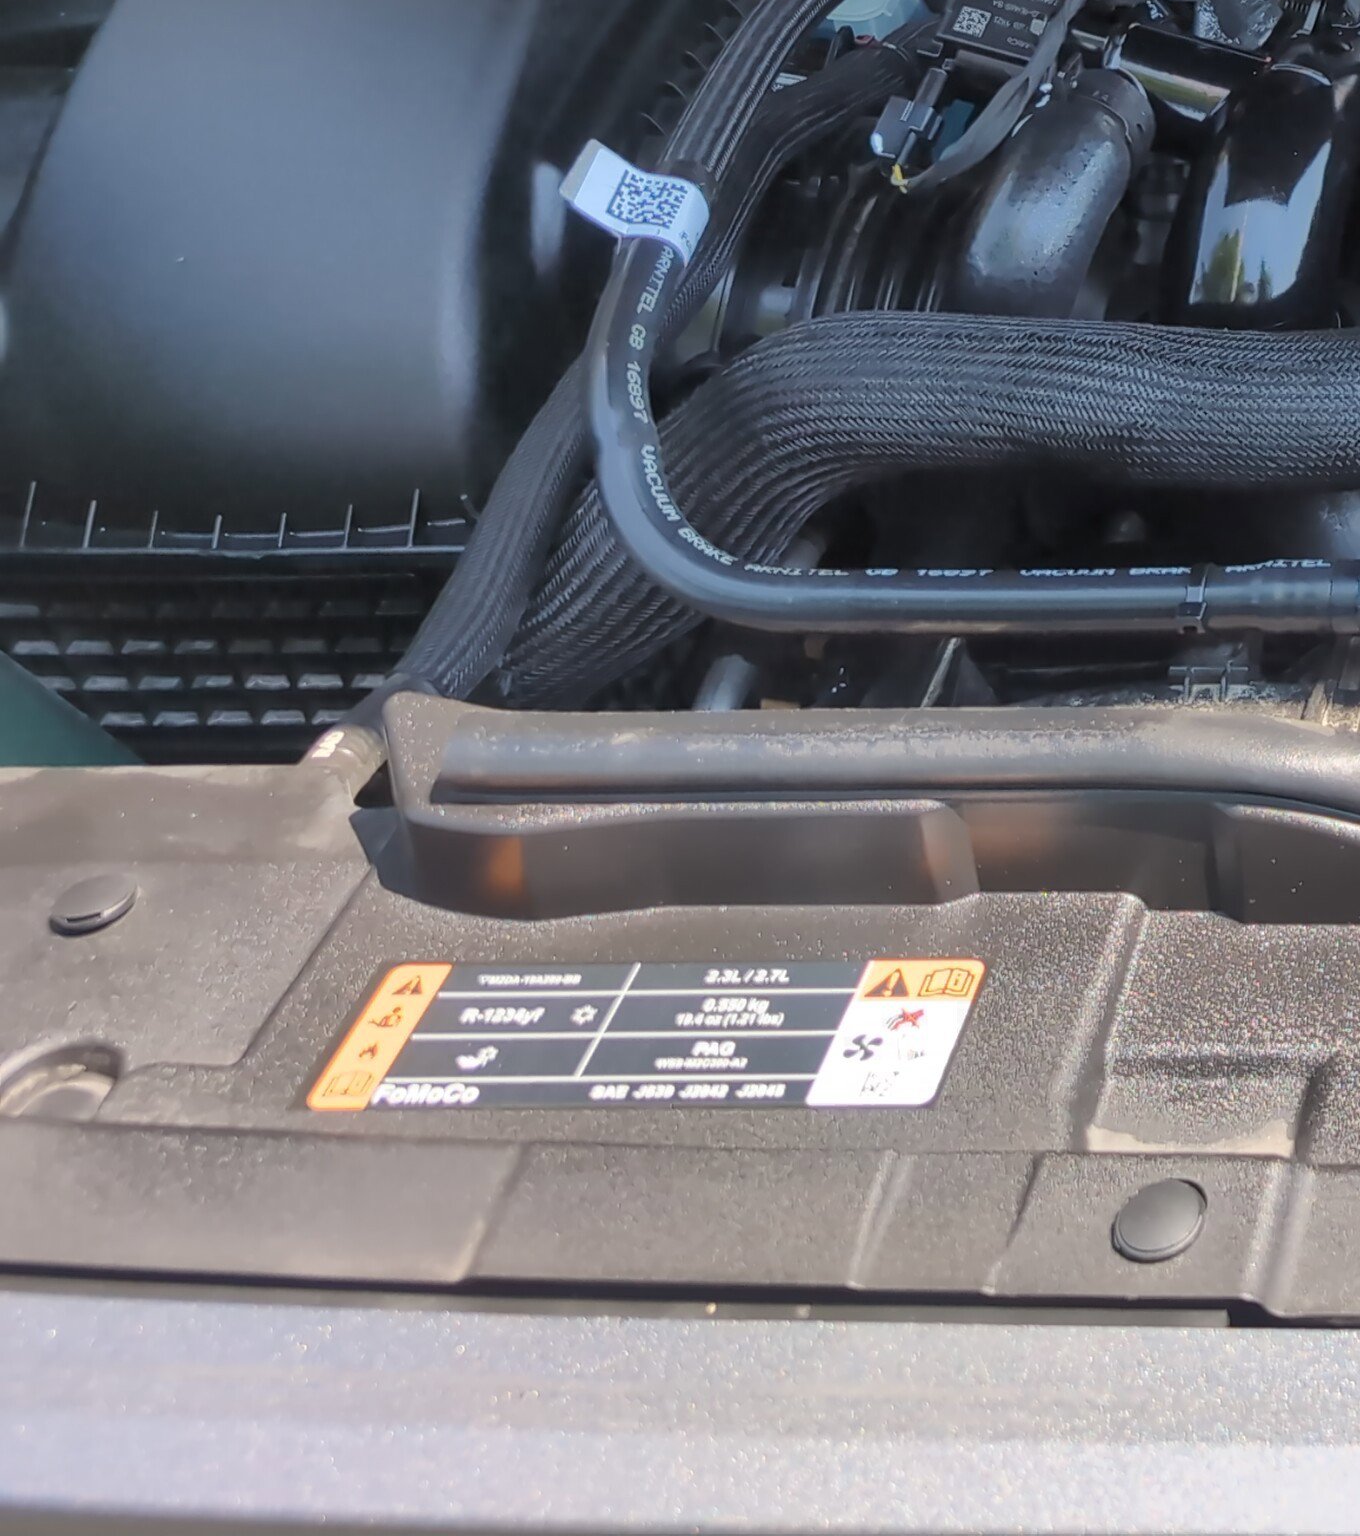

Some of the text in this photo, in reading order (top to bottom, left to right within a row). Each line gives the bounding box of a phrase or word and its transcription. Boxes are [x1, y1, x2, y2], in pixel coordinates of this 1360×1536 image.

[636, 244, 676, 315] ARNITEL
[628, 323, 647, 352] GB
[625, 360, 650, 425] 16897
[640, 443, 682, 523] VACUUM
[677, 526, 740, 567] BRAKE
[1128, 566, 1192, 576] BRAK
[704, 968, 742, 983] 2.3L
[752, 968, 790, 983] 2.7L
[457, 1006, 545, 1025] R-1234yf
[690, 1040, 736, 1057] PAG
[371, 1083, 480, 1105] FoMoCo
